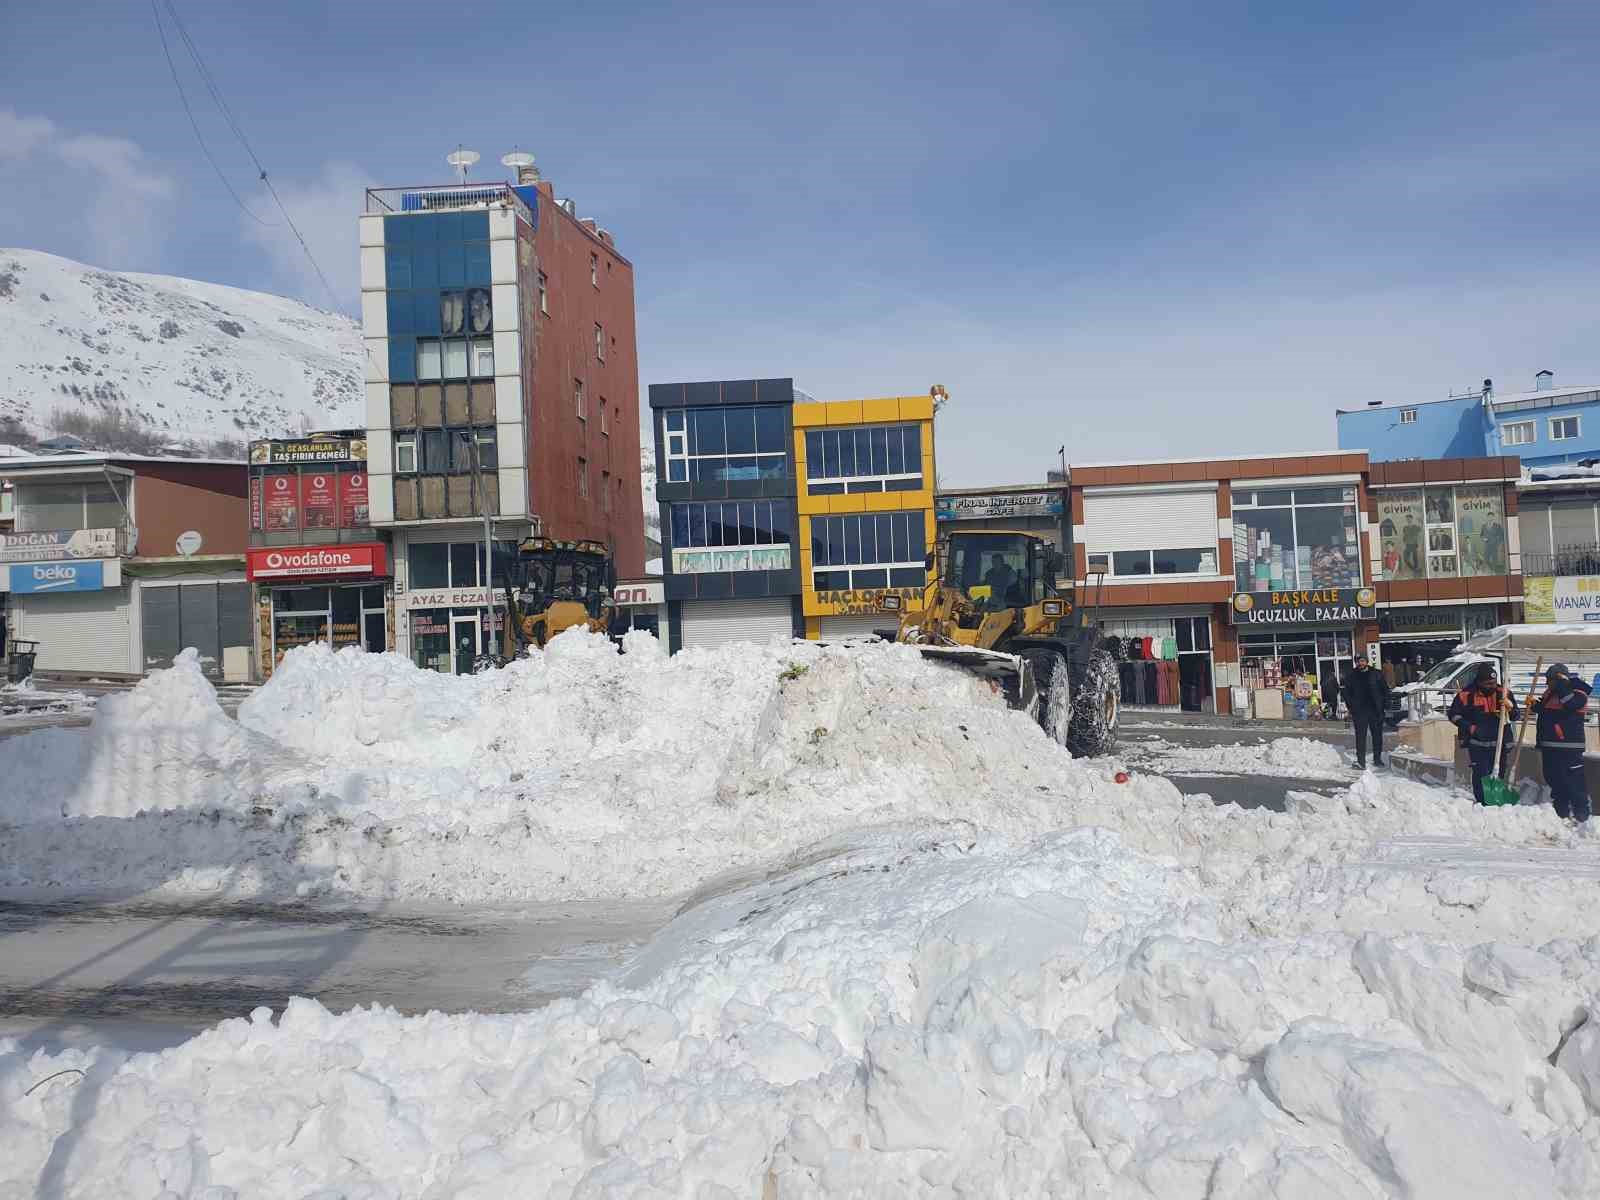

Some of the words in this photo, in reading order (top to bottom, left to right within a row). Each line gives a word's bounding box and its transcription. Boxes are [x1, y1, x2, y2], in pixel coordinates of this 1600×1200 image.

[274, 453, 290, 463] TAŞ
[316, 448, 348, 460] EKMEĞİ
[284, 551, 351, 565] vodafone
[32, 565, 76, 579] beko
[412, 595, 445, 605] AYAZ
[1272, 590, 1339, 607] BAŞKALE
[1555, 596, 1592, 608] MANAV
[1248, 609, 1305, 623] UCUZLUK
[1316, 607, 1361, 620] PAZARI
